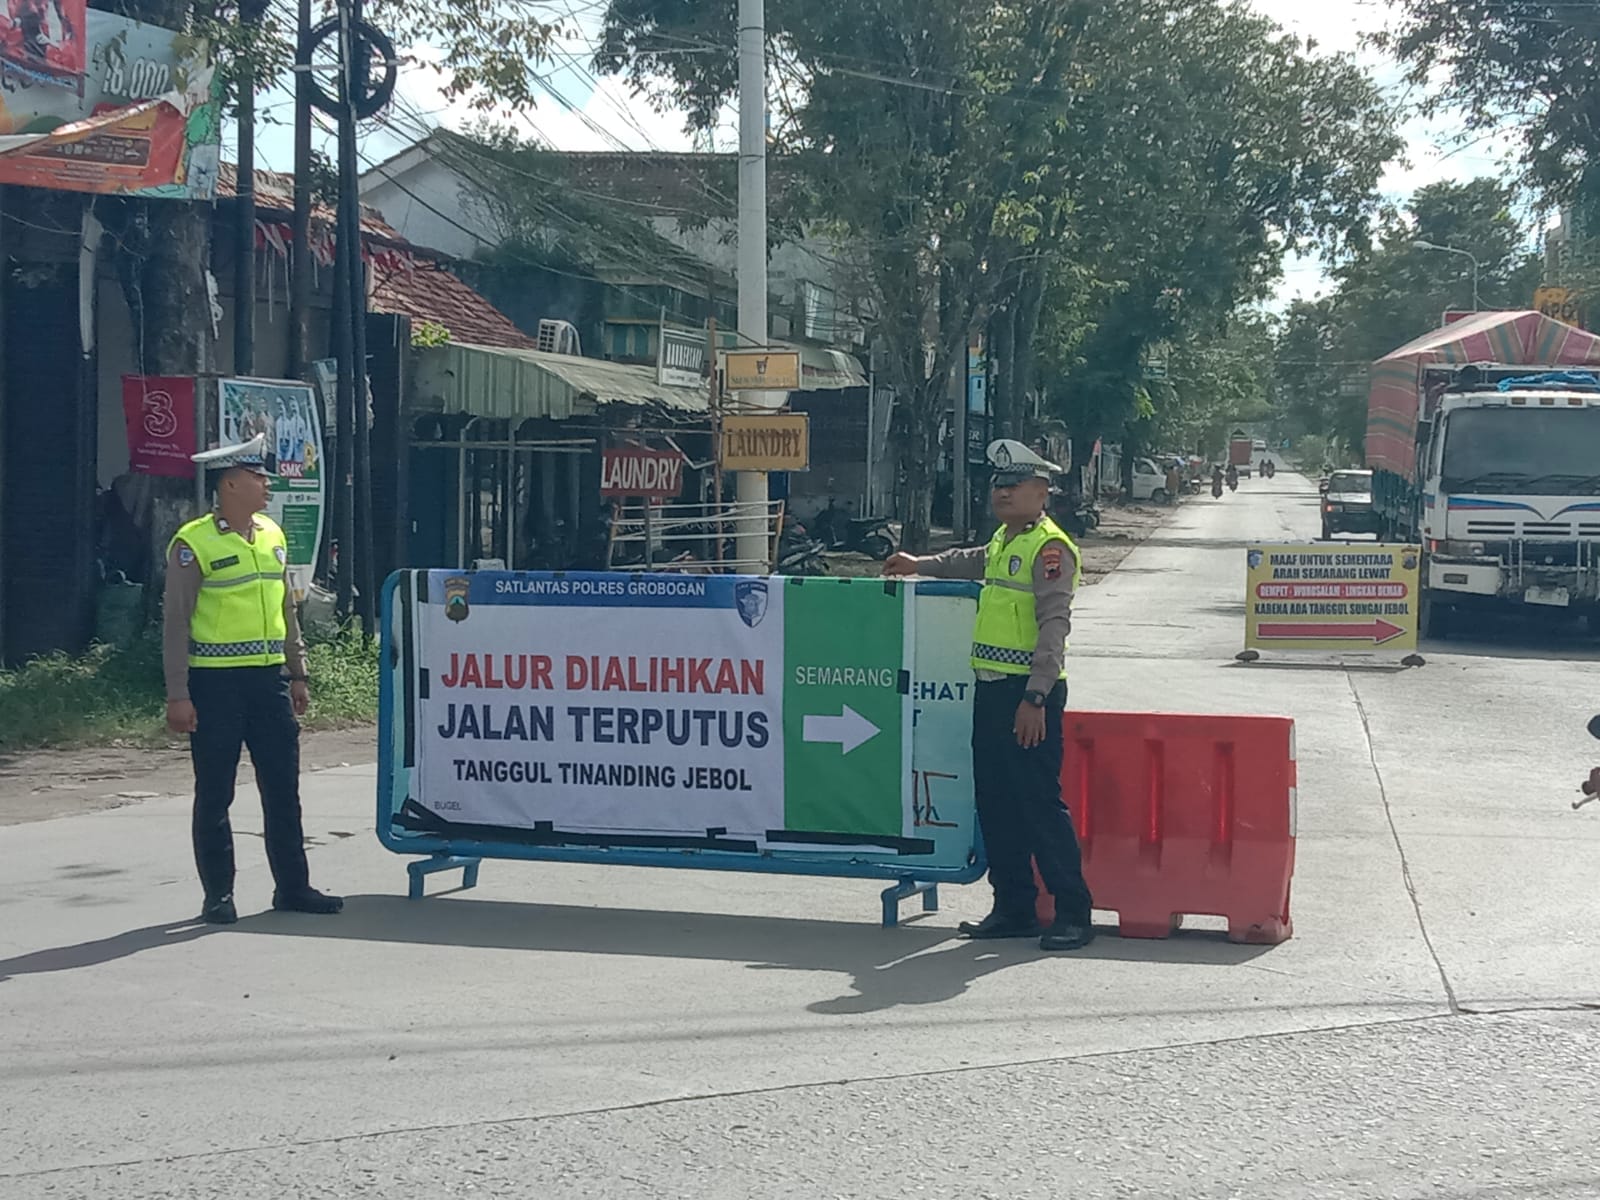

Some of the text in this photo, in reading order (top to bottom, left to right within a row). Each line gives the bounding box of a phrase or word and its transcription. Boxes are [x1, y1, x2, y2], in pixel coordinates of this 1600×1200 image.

[144, 390, 177, 437] 3
[727, 428, 802, 458] LAUNDRY
[280, 463, 303, 476] SMK
[601, 456, 682, 490] LAUNDRY
[1270, 554, 1393, 566] MAAF UNTUK SEMENTARA
[1273, 568, 1391, 580] ARAH SEMARANG LEWAT
[495, 580, 705, 596] SATLANTAS POLRES GROBOGAN
[1255, 603, 1409, 615] KARENA ADA TANGGUL SUNGAI JEBOL
[441, 653, 764, 695] JALUR DIALIHKAN
[795, 666, 893, 687] SEMARANG
[438, 703, 769, 748] JALAN TERPUTUS
[453, 759, 752, 791] TANGGUL TINANDING JEBOL
